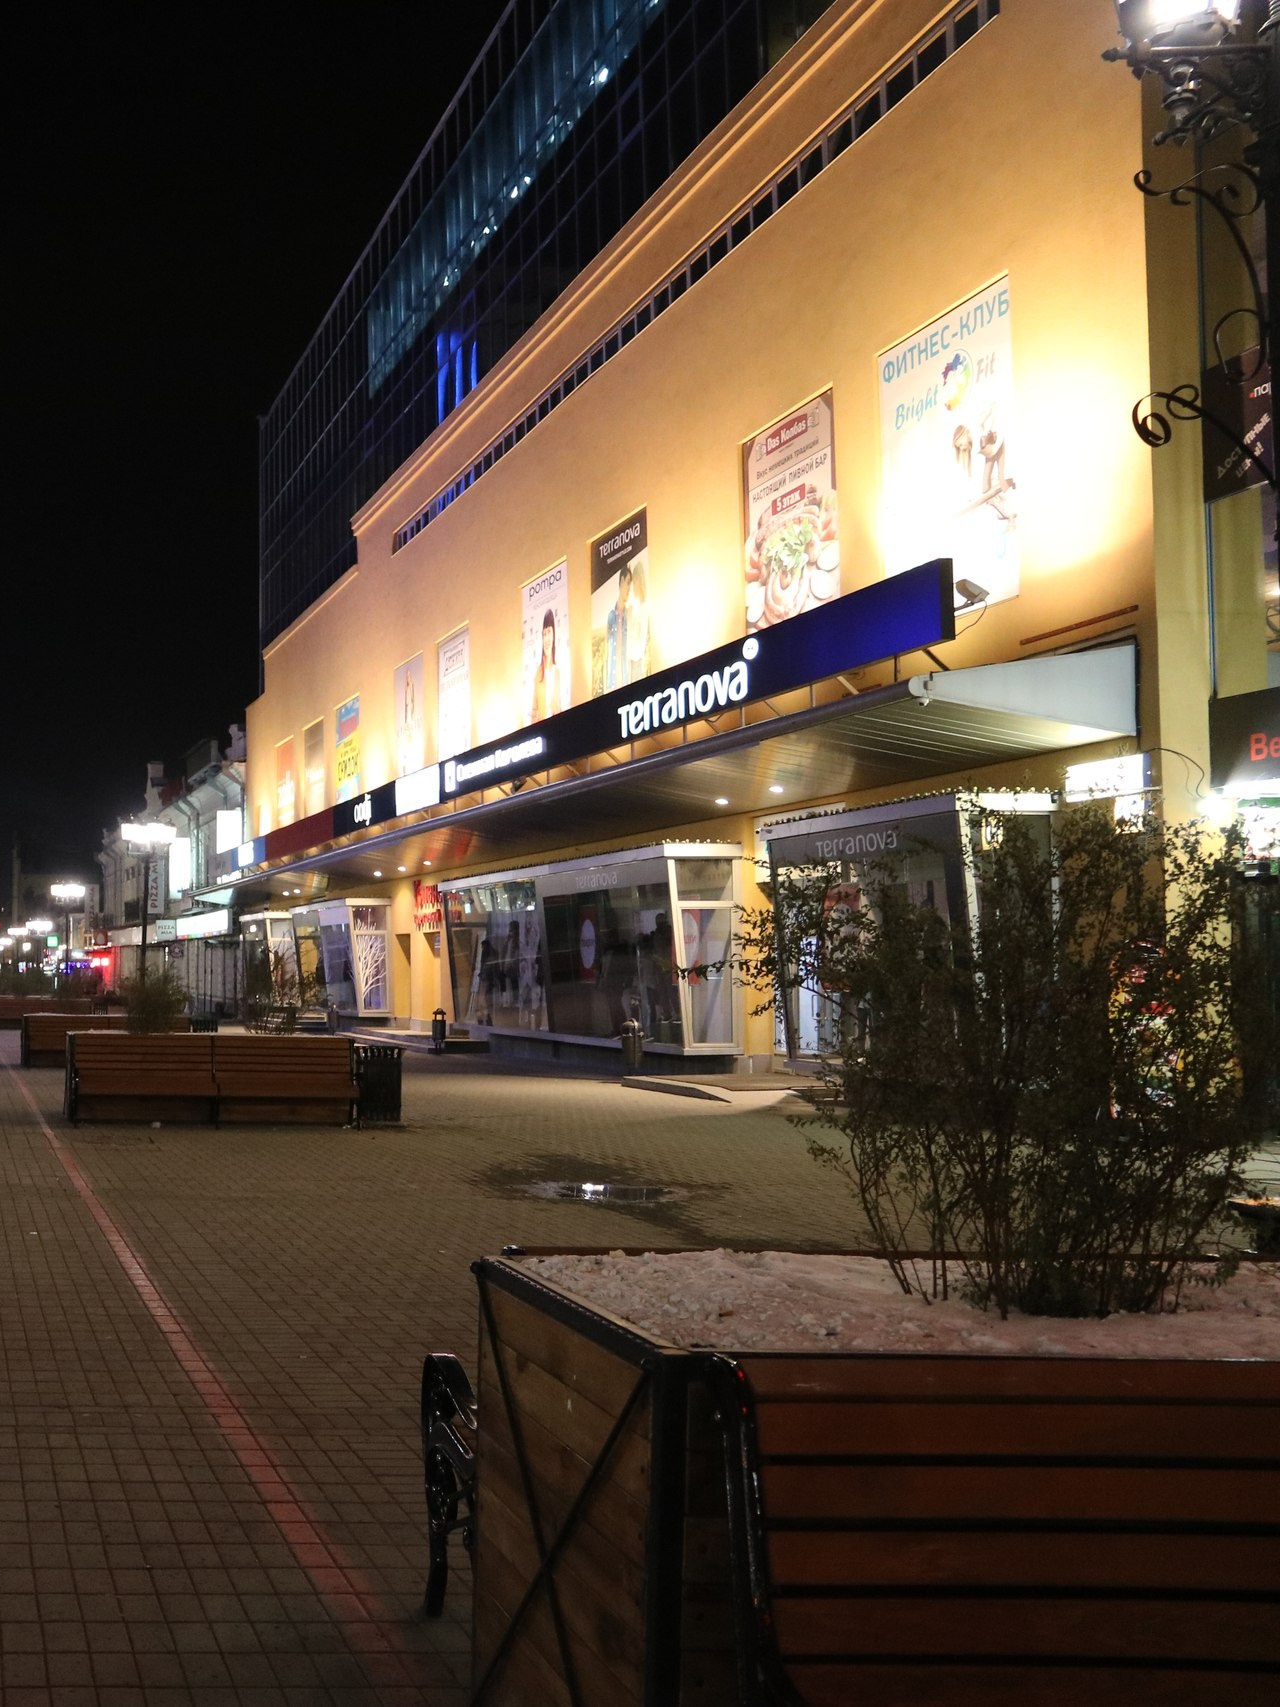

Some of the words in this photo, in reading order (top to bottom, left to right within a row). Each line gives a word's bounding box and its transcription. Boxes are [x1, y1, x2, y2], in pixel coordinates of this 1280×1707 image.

[883, 289, 1009, 383] ФИТНЕС-КЛУБ
[895, 384, 938, 430] Bright
[976, 352, 996, 383] Fit
[752, 474, 787, 504] НАСТОЯЩИЙ
[788, 457, 814, 483] ПИВНОЙ
[814, 453, 828, 469] БАР
[776, 497, 782, 512] 5
[781, 490, 801, 508] этаж
[528, 569, 562, 601] pompa
[150, 876, 159, 909] PIZZA
